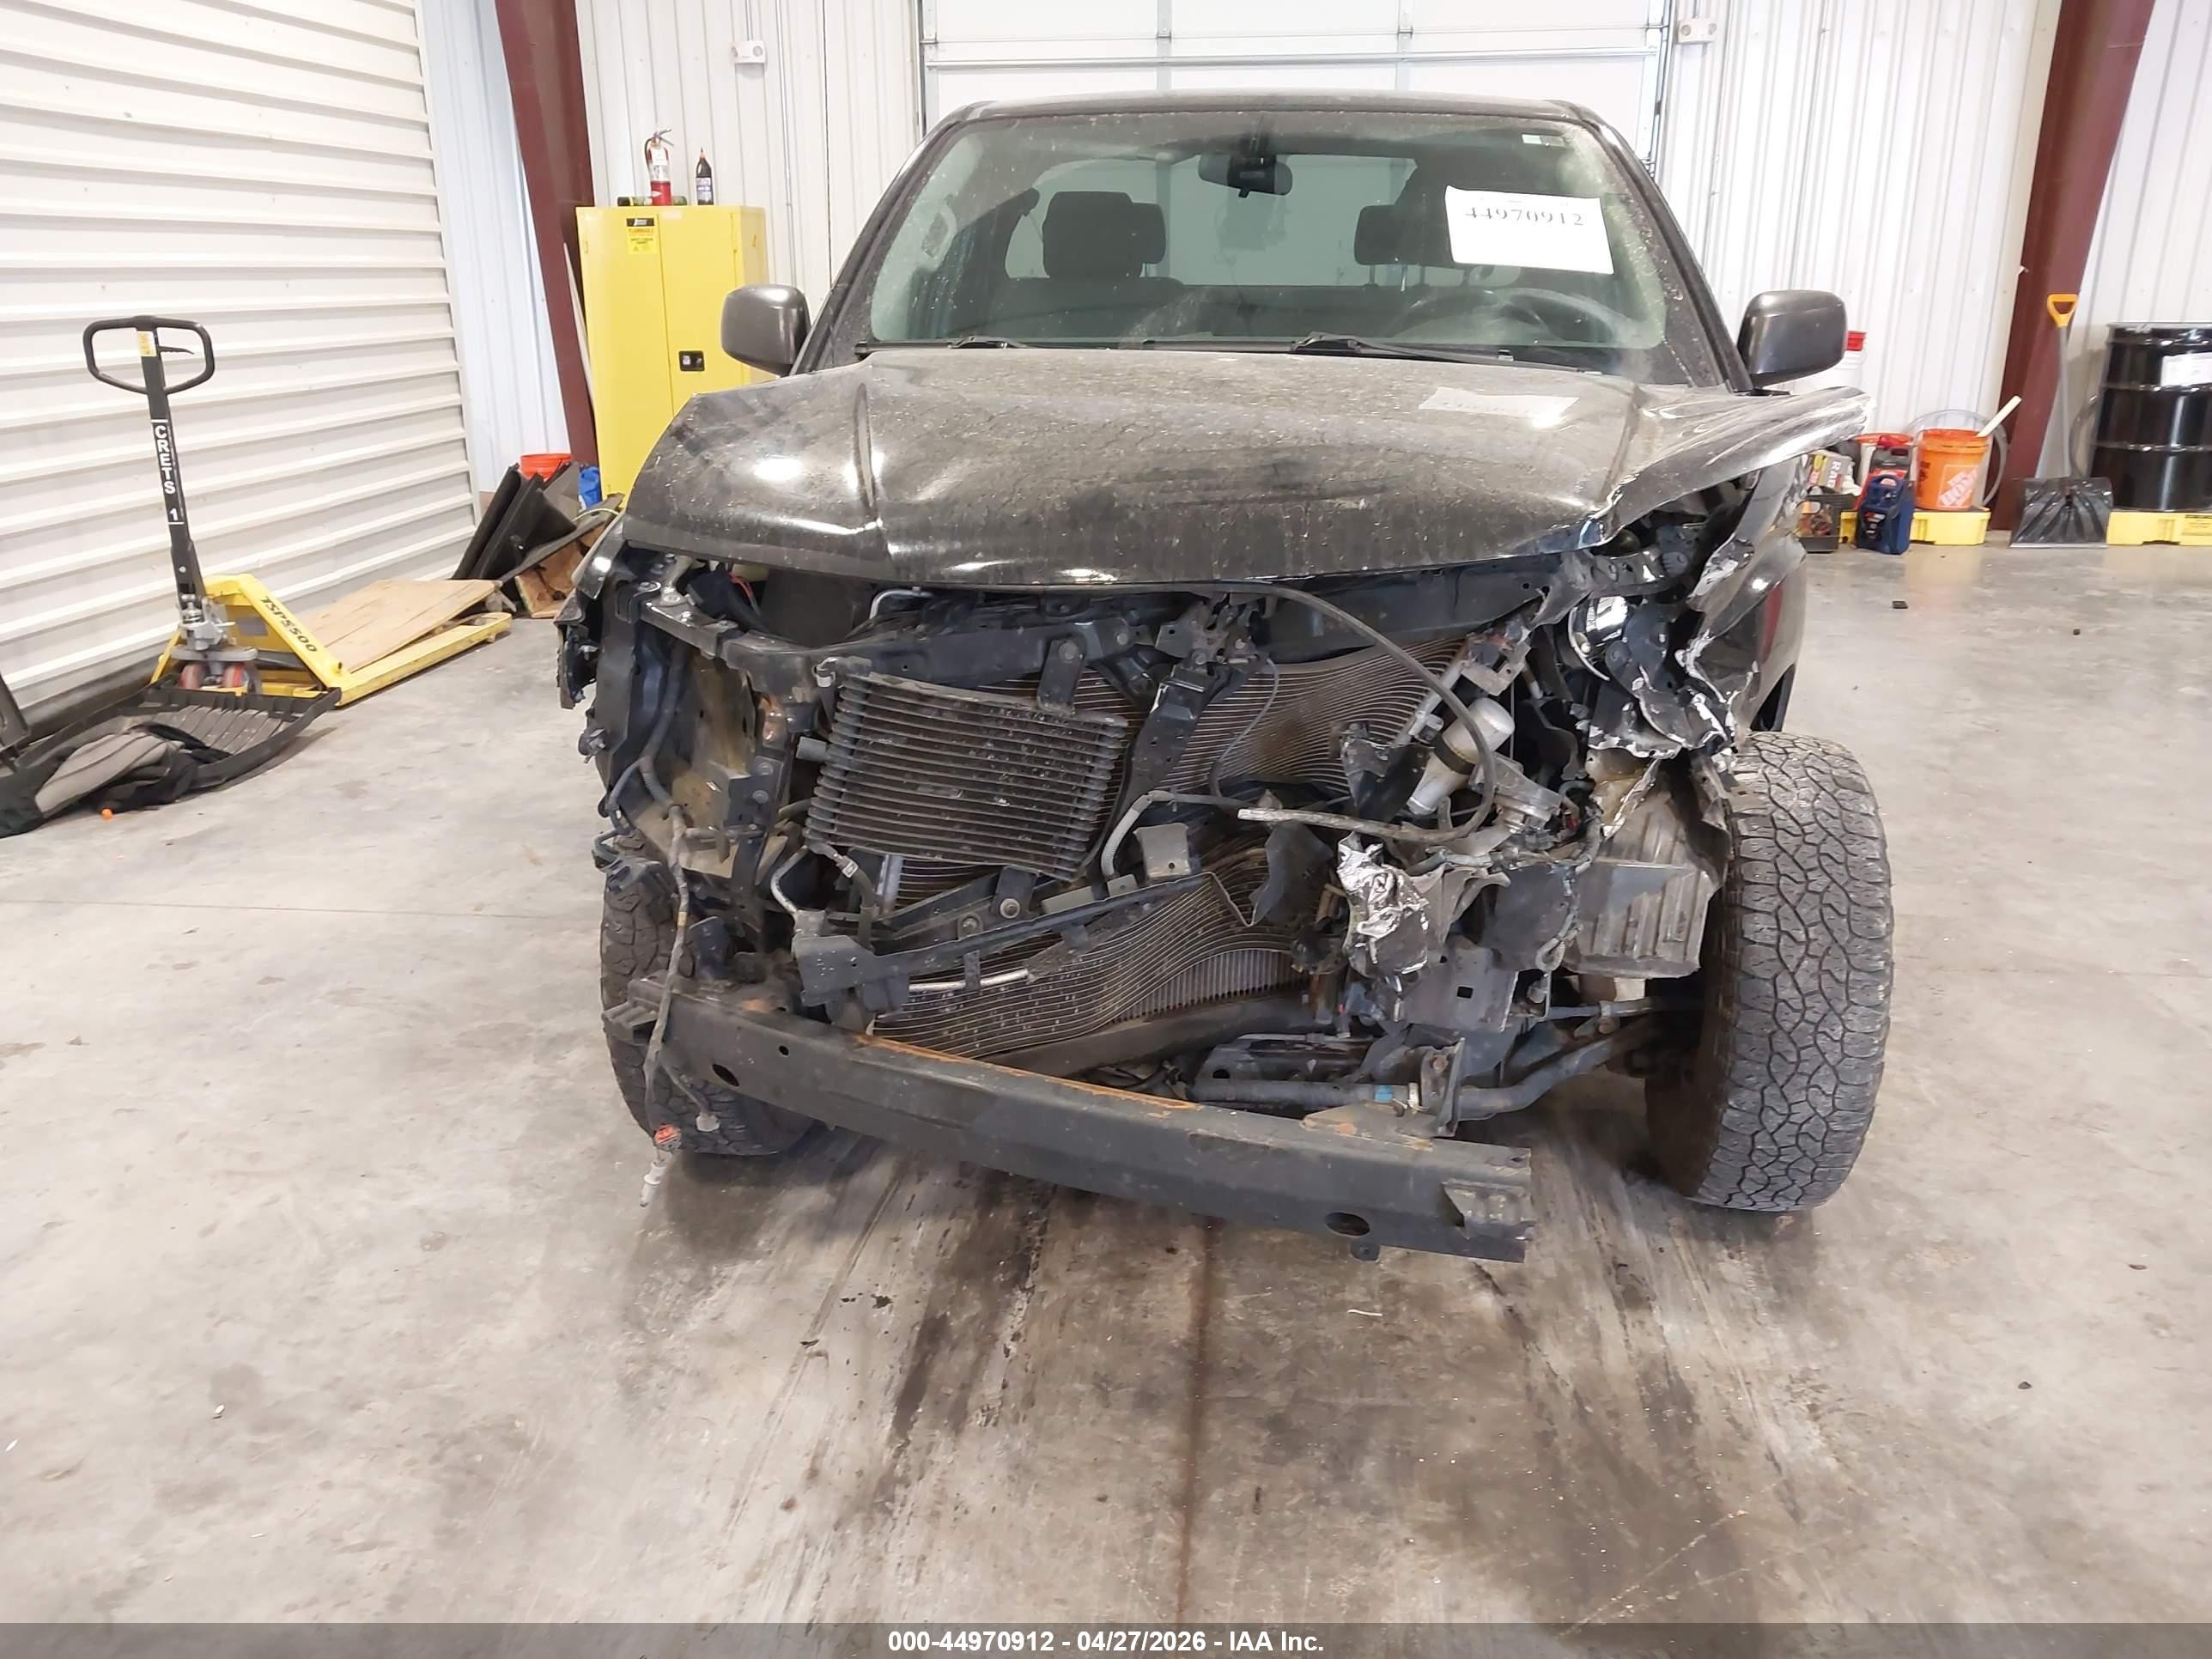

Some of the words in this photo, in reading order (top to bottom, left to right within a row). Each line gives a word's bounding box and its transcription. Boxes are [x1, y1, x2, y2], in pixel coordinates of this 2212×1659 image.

[1465, 206, 1584, 226] 44970912
[155, 424, 176, 495] CRETS
[170, 507, 179, 521] 1
